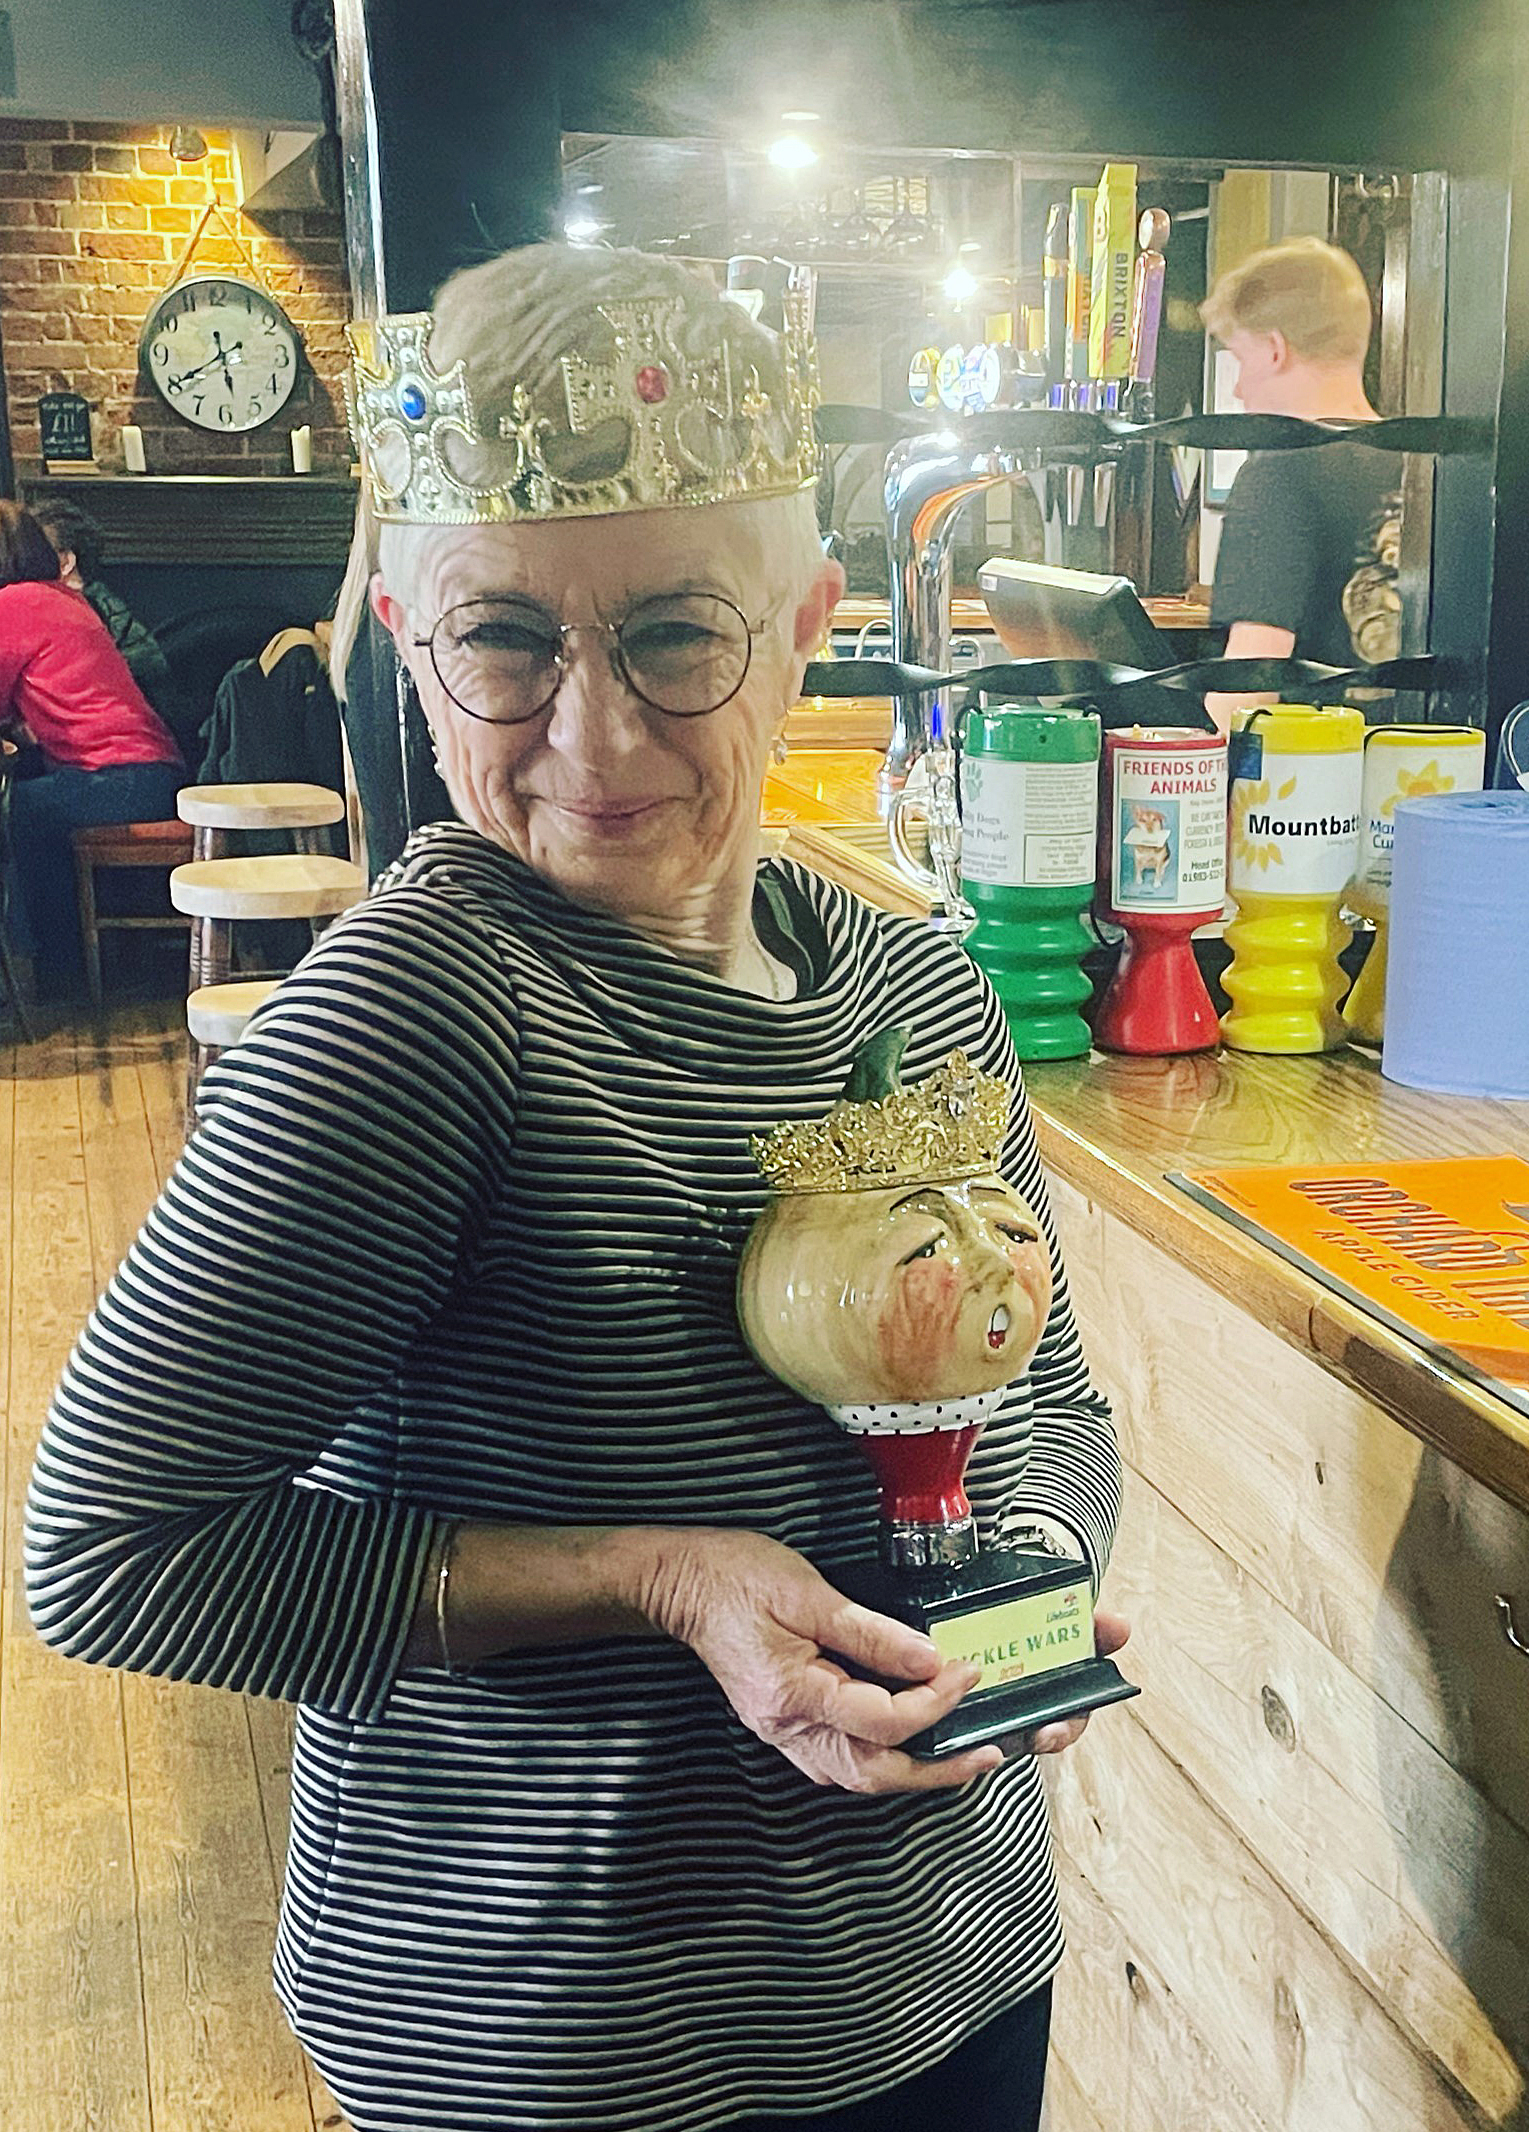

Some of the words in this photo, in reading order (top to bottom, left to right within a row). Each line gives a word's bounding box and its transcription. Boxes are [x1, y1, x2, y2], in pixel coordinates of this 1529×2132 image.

[182, 290, 196, 312] 11
[209, 285, 227, 307] 12
[1113, 253, 1128, 338] BRIXTON
[158, 313, 178, 333] 10
[262, 312, 276, 336] 2
[154, 343, 168, 366] 9
[275, 344, 289, 368] 3
[168, 373, 183, 396] 8
[265, 373, 282, 395] 4
[193, 394, 207, 416] 7
[218, 404, 232, 425] 6
[248, 394, 261, 417] 5
[1123, 760, 1194, 775] FRIENDS
[1198, 760, 1214, 775] OF
[1150, 779, 1217, 795] ANIMALS
[1289, 1179, 1527, 1272] ORCHARD
[1313, 1230, 1403, 1271] APPLE
[1391, 1275, 1479, 1320] CIDER
[1026, 1624, 1080, 1652] WARS
